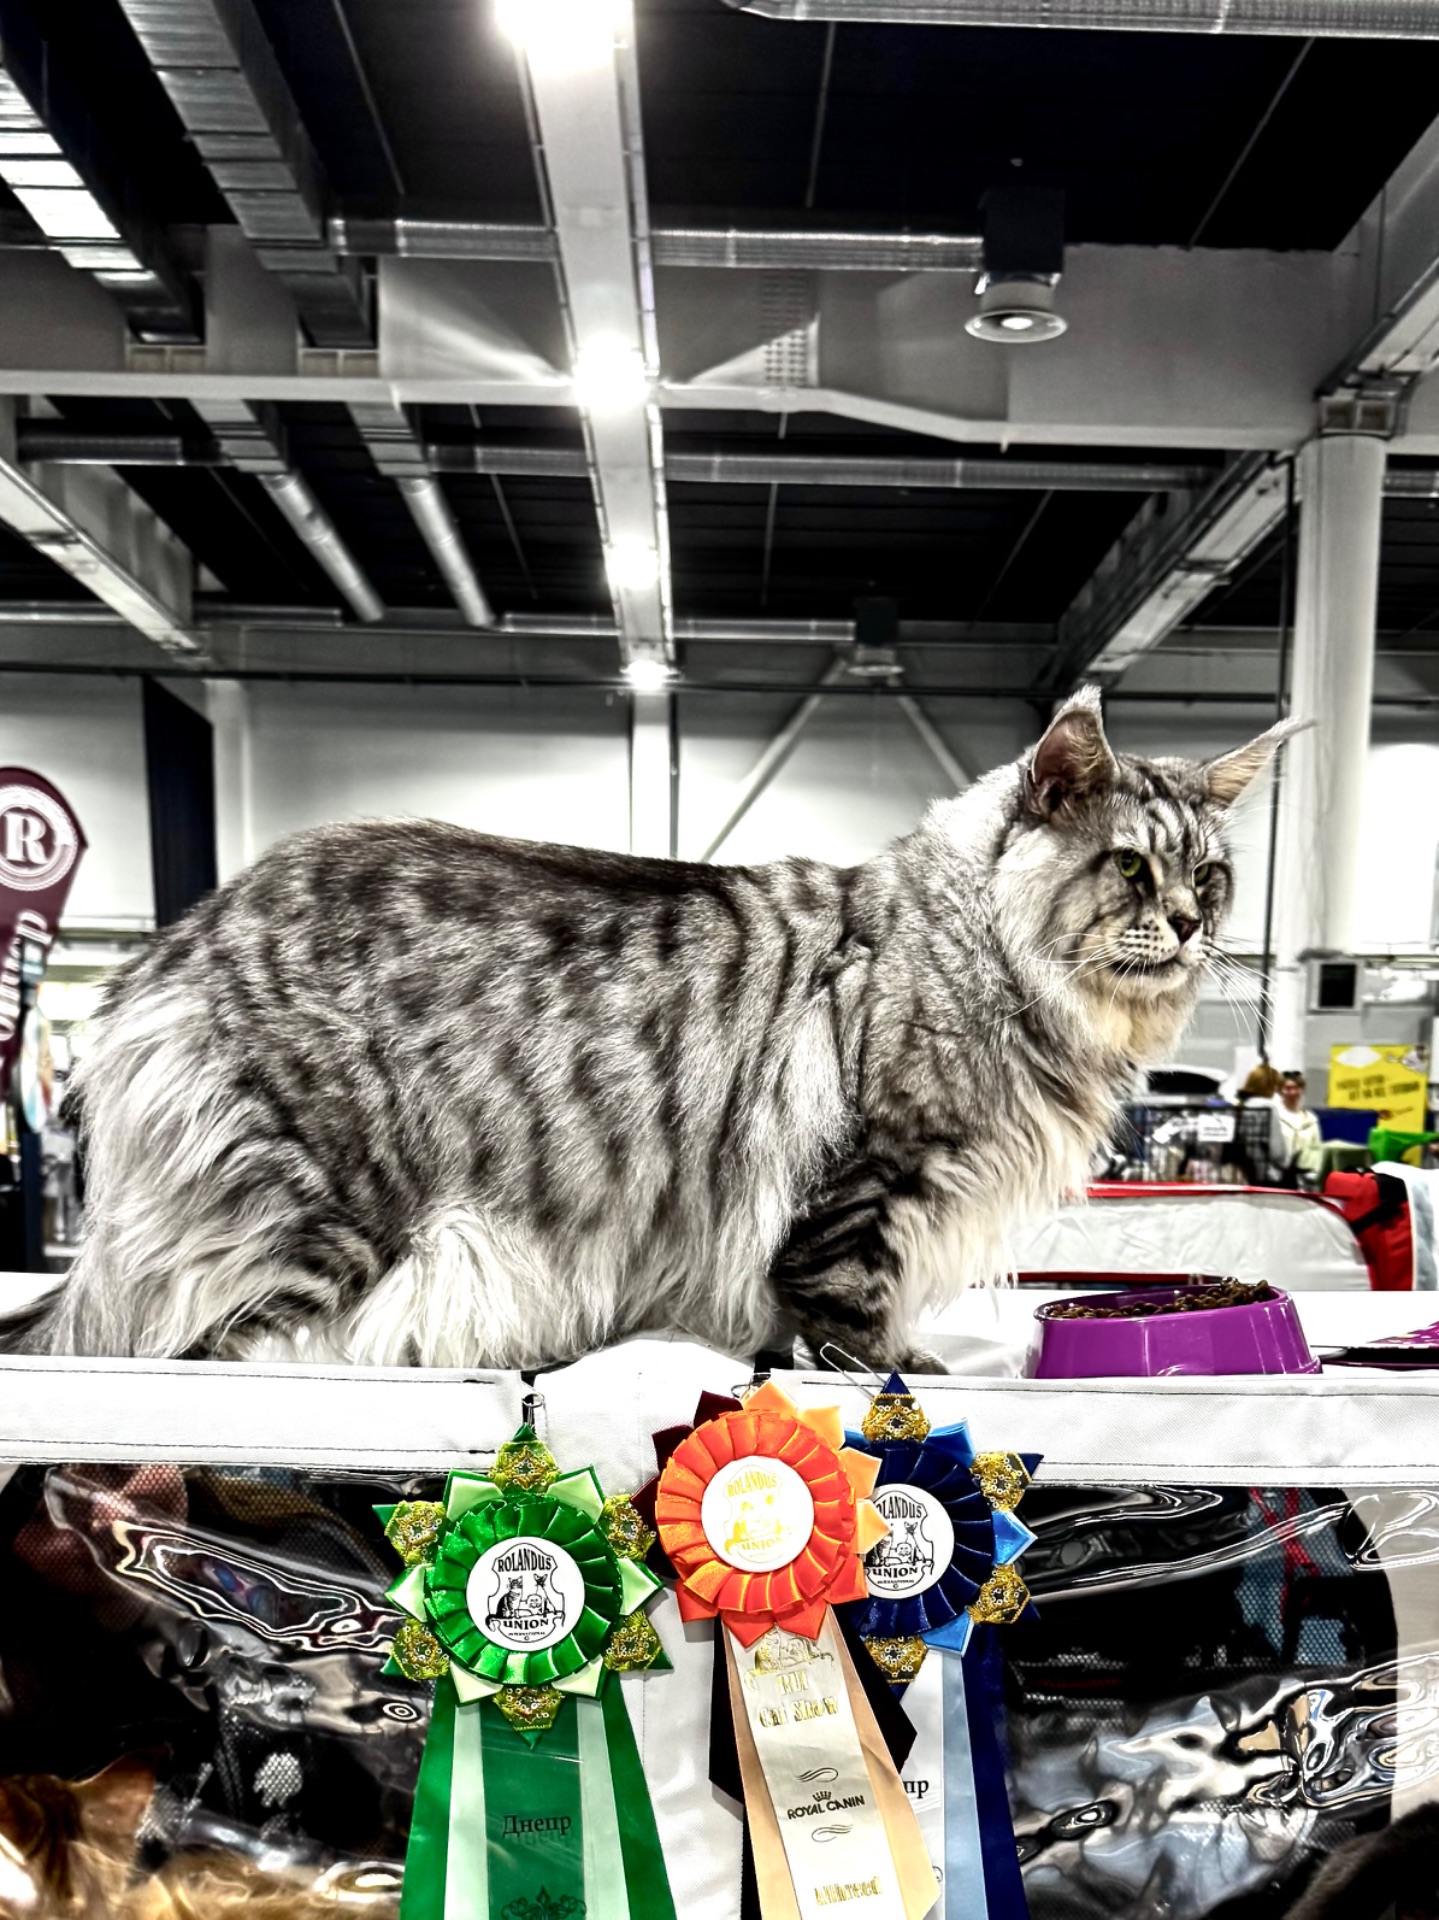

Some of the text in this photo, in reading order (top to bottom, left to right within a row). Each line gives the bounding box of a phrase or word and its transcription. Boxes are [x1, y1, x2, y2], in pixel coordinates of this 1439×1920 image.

[727, 1470, 777, 1497] ROLANDUS
[741, 1537, 783, 1551] UNION
[498, 1548, 552, 1572] ROLANDUS
[872, 1567, 918, 1578] UNION
[503, 1619, 549, 1630] UNION
[792, 1696, 838, 1722] Show
[787, 1795, 865, 1820] ROYAL CANIN
[502, 1814, 572, 1837] Днепр
[813, 1876, 882, 1906] Allbreed
